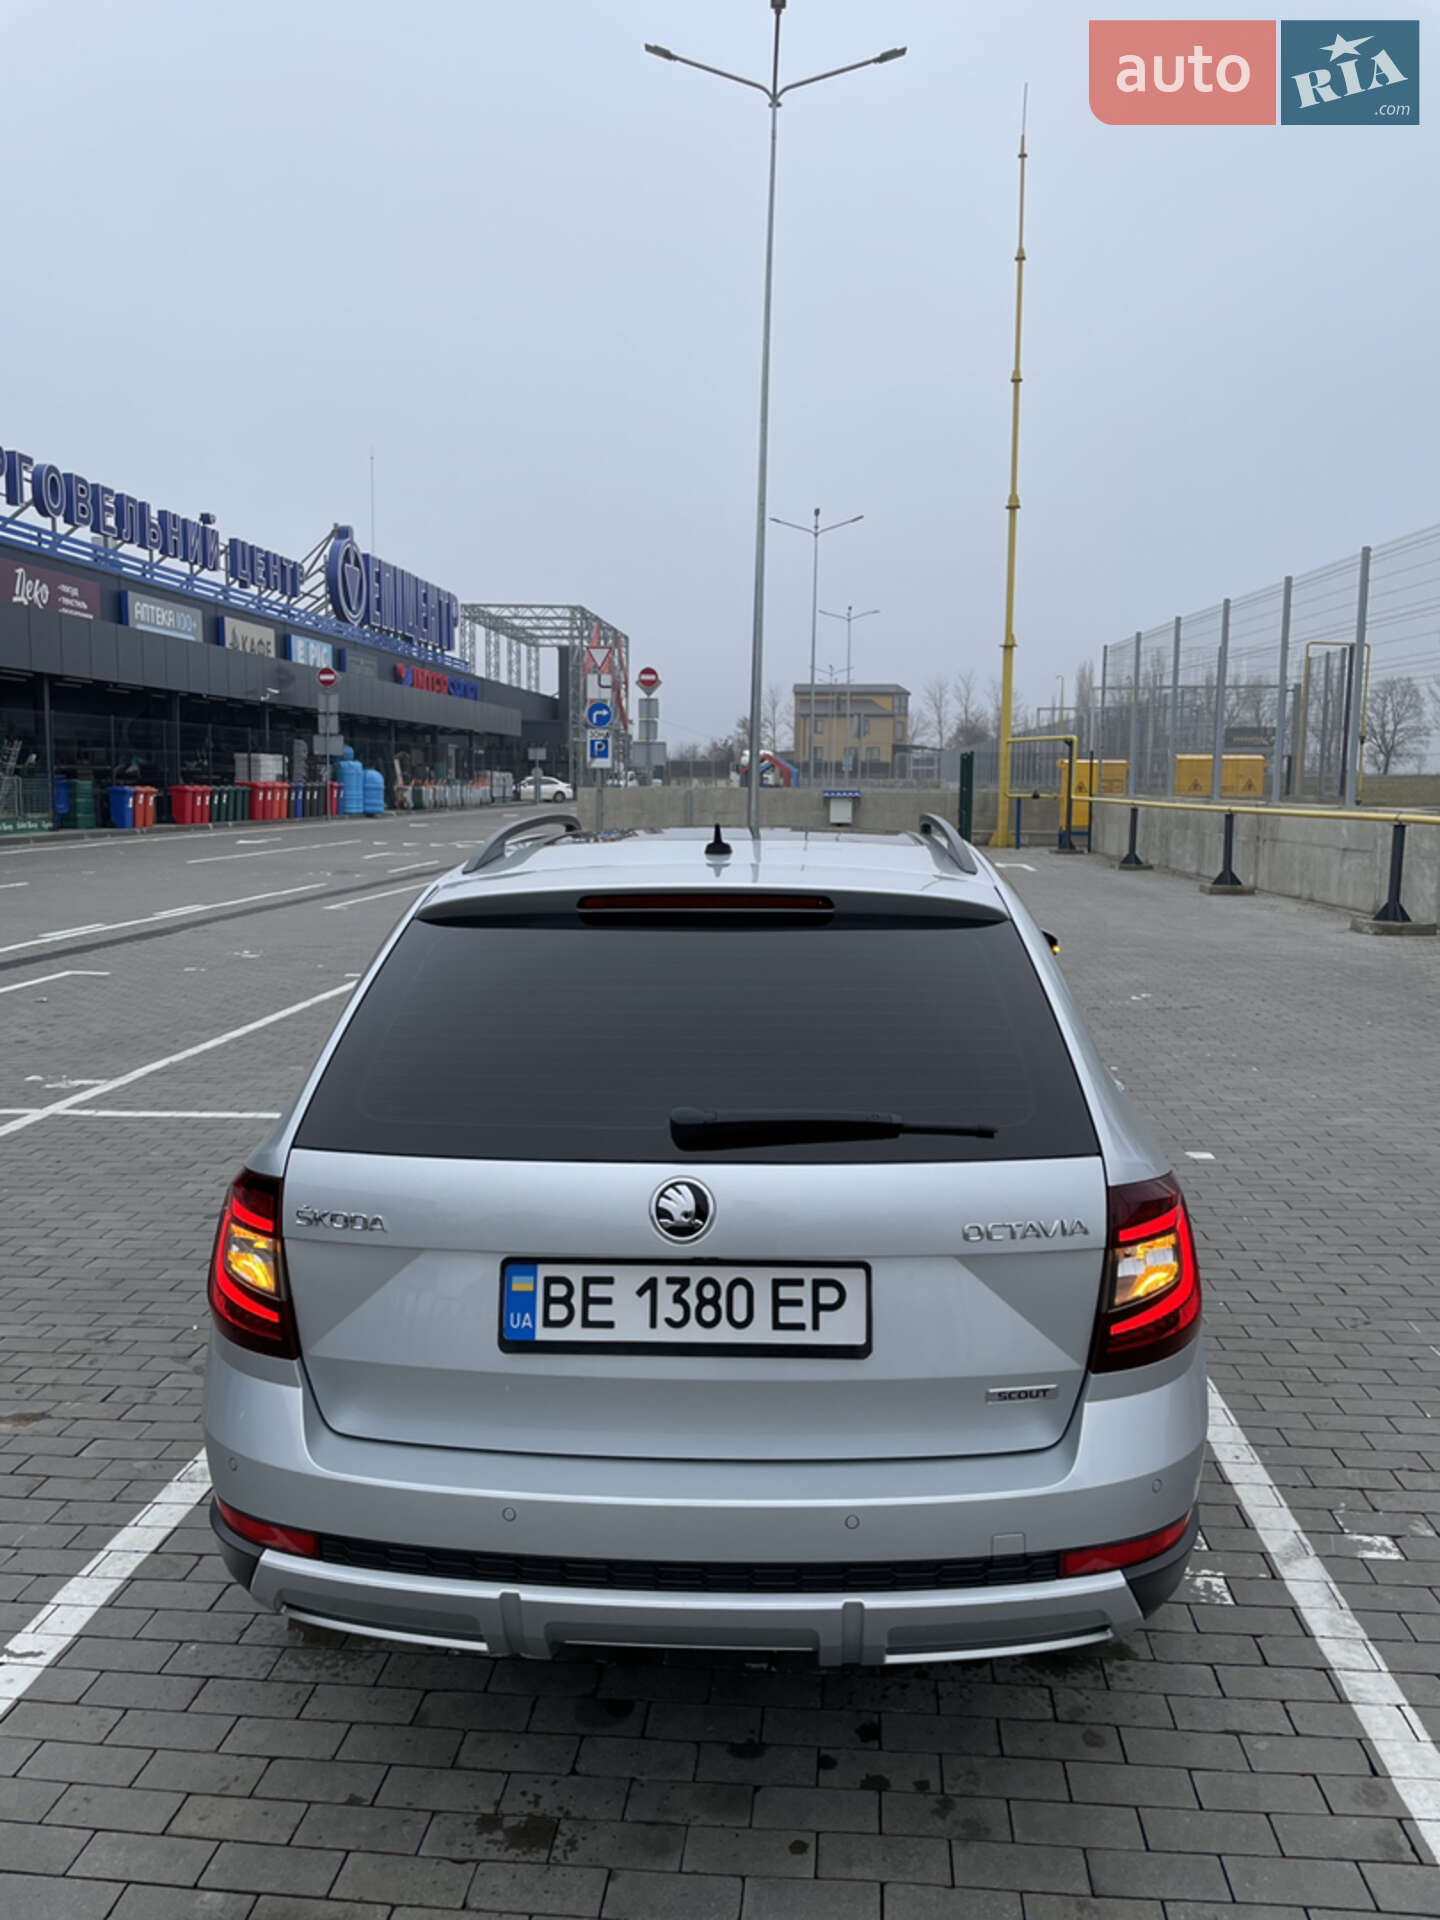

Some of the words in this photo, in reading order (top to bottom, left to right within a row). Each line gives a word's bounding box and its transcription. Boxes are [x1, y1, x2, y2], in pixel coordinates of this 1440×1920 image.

[228, 538, 304, 598] ЦЕНТР
[134, 601, 176, 629] АПТЕКА
[962, 1217, 1089, 1242] OCTAVIA
[542, 1276, 615, 1329] BE
[635, 1276, 754, 1330] 1380
[771, 1278, 847, 1331] EP
[509, 1312, 533, 1329] UA
[997, 1389, 1050, 1402] SCOUT
